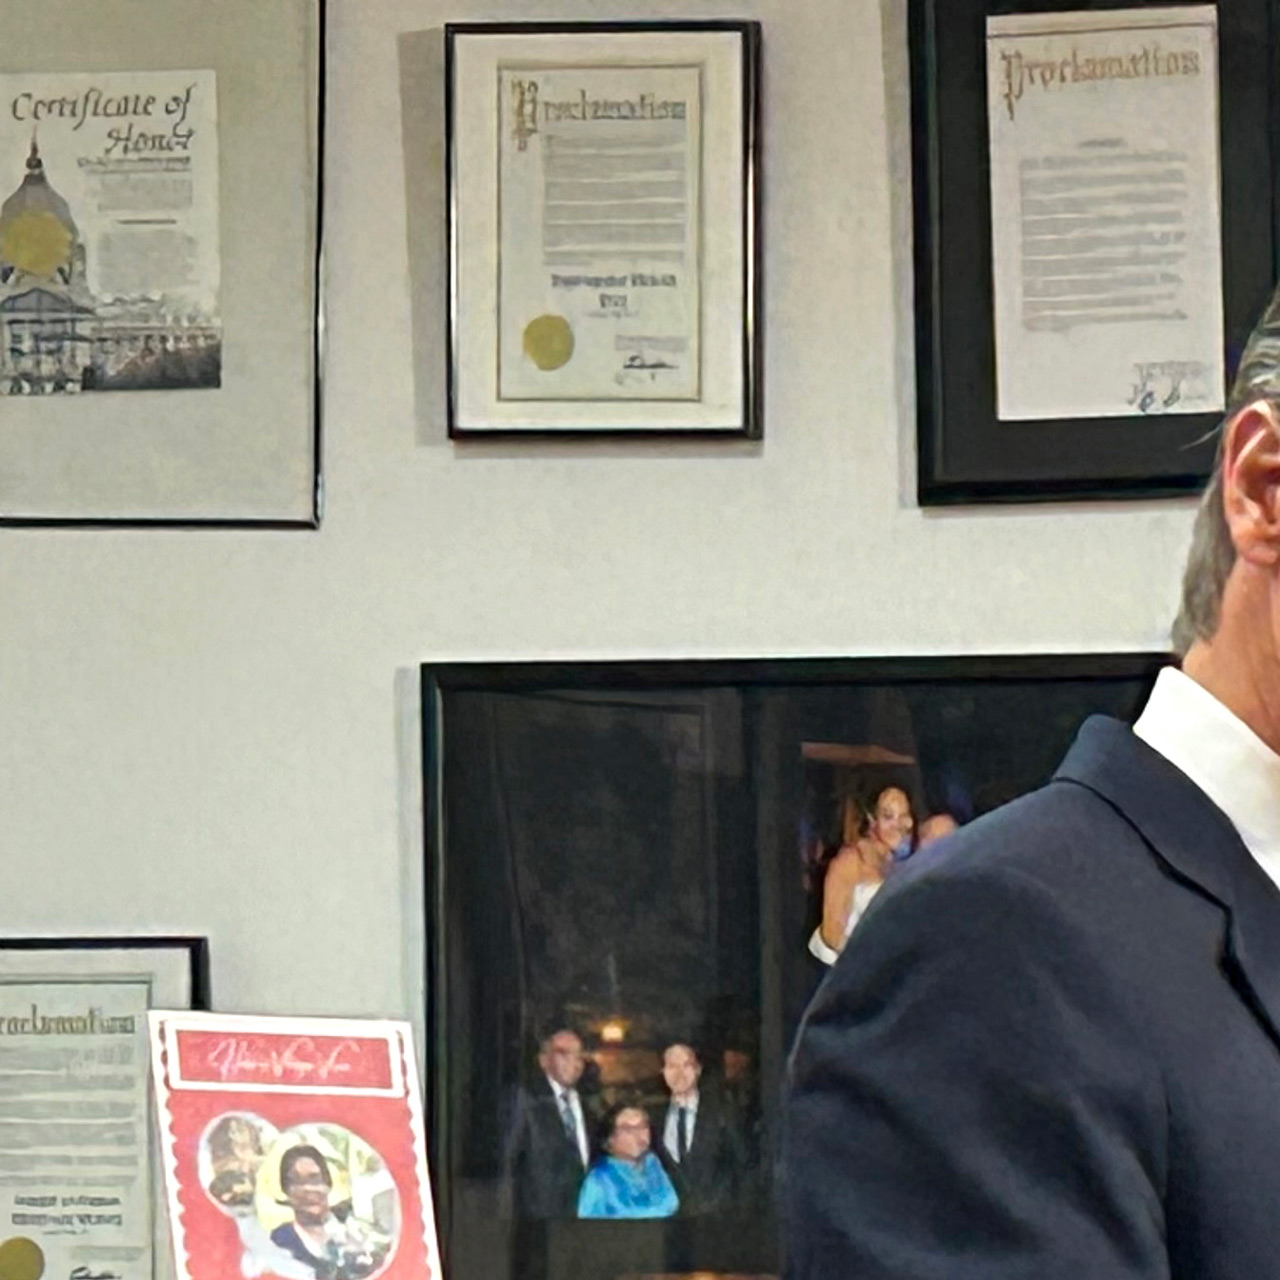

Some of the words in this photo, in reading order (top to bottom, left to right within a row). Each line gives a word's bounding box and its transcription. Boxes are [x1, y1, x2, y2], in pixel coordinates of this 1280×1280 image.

[12, 87, 156, 131] Certificate
[164, 82, 197, 138] of
[1001, 48, 1199, 121] Proclamation
